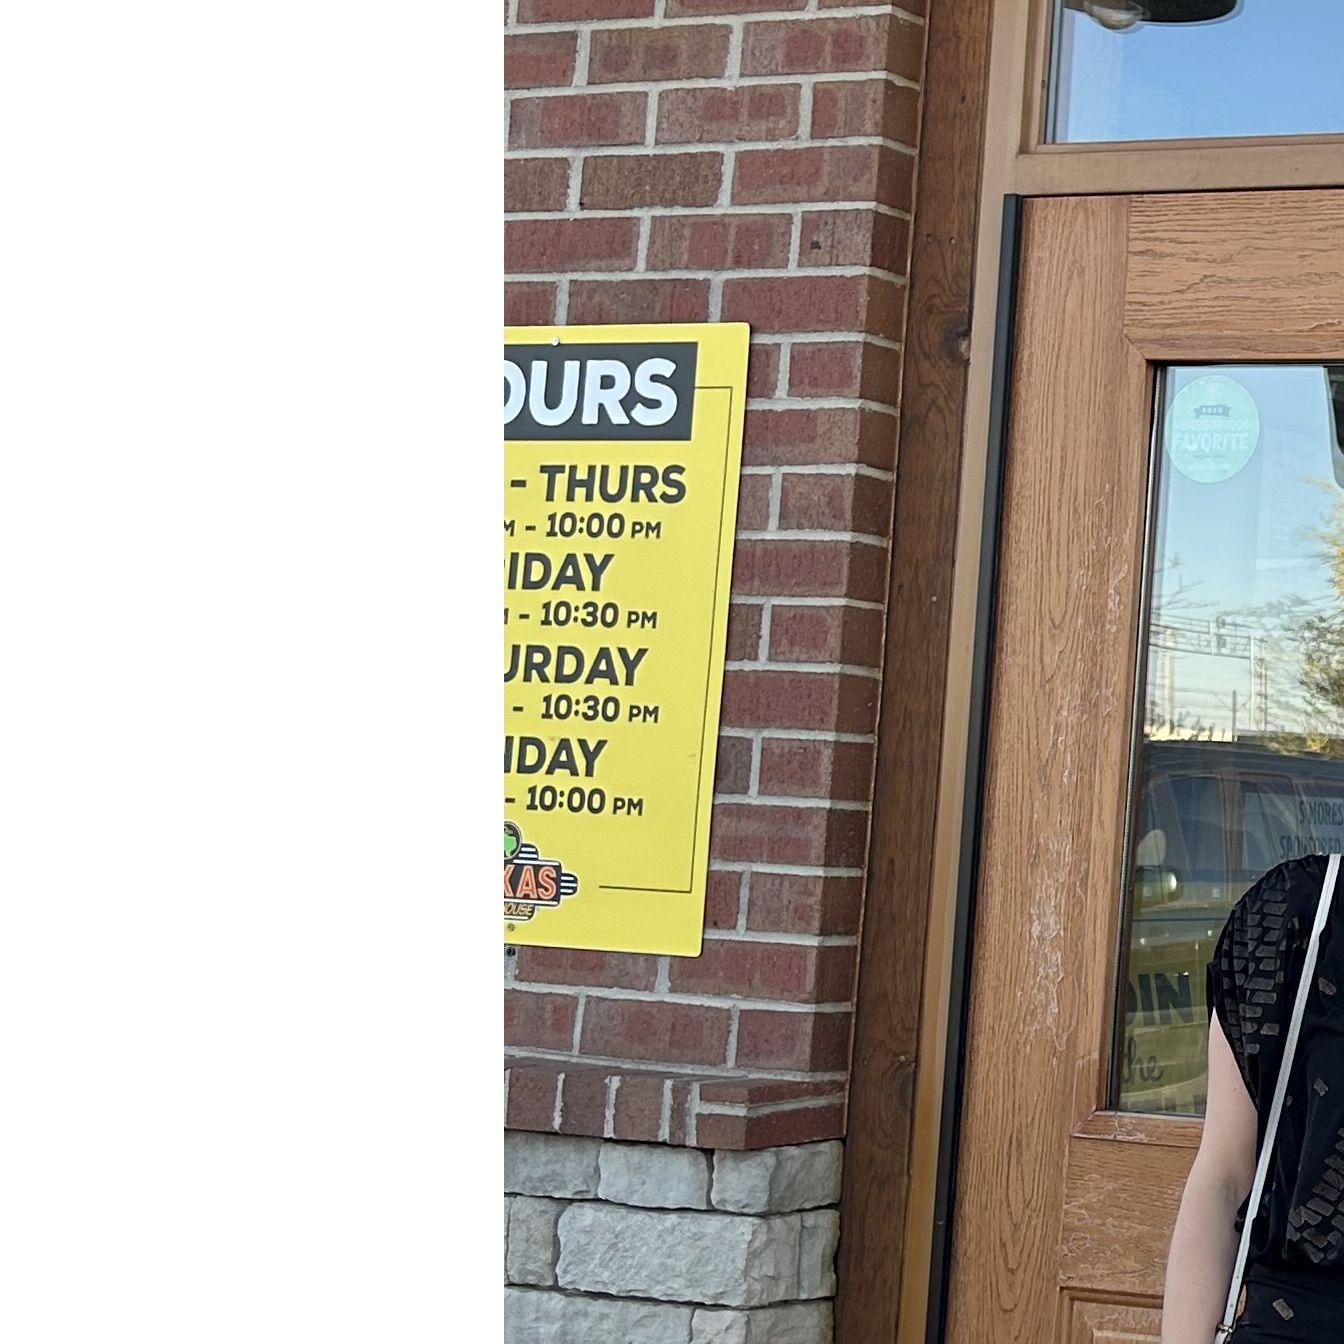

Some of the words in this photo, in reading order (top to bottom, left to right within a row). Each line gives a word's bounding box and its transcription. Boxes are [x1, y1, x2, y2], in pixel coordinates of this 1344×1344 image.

[1174, 432, 1249, 453] FAVORITE
[539, 464, 687, 503] THURS
[545, 511, 625, 539] 10:00
[631, 521, 662, 539] PM
[504, 552, 615, 591] IDAY
[541, 600, 620, 629] 10:30
[627, 611, 658, 629] PM
[541, 694, 620, 722] 10:30
[628, 704, 660, 723] PM
[526, 785, 606, 814] 10:00
[612, 797, 644, 816] PM
